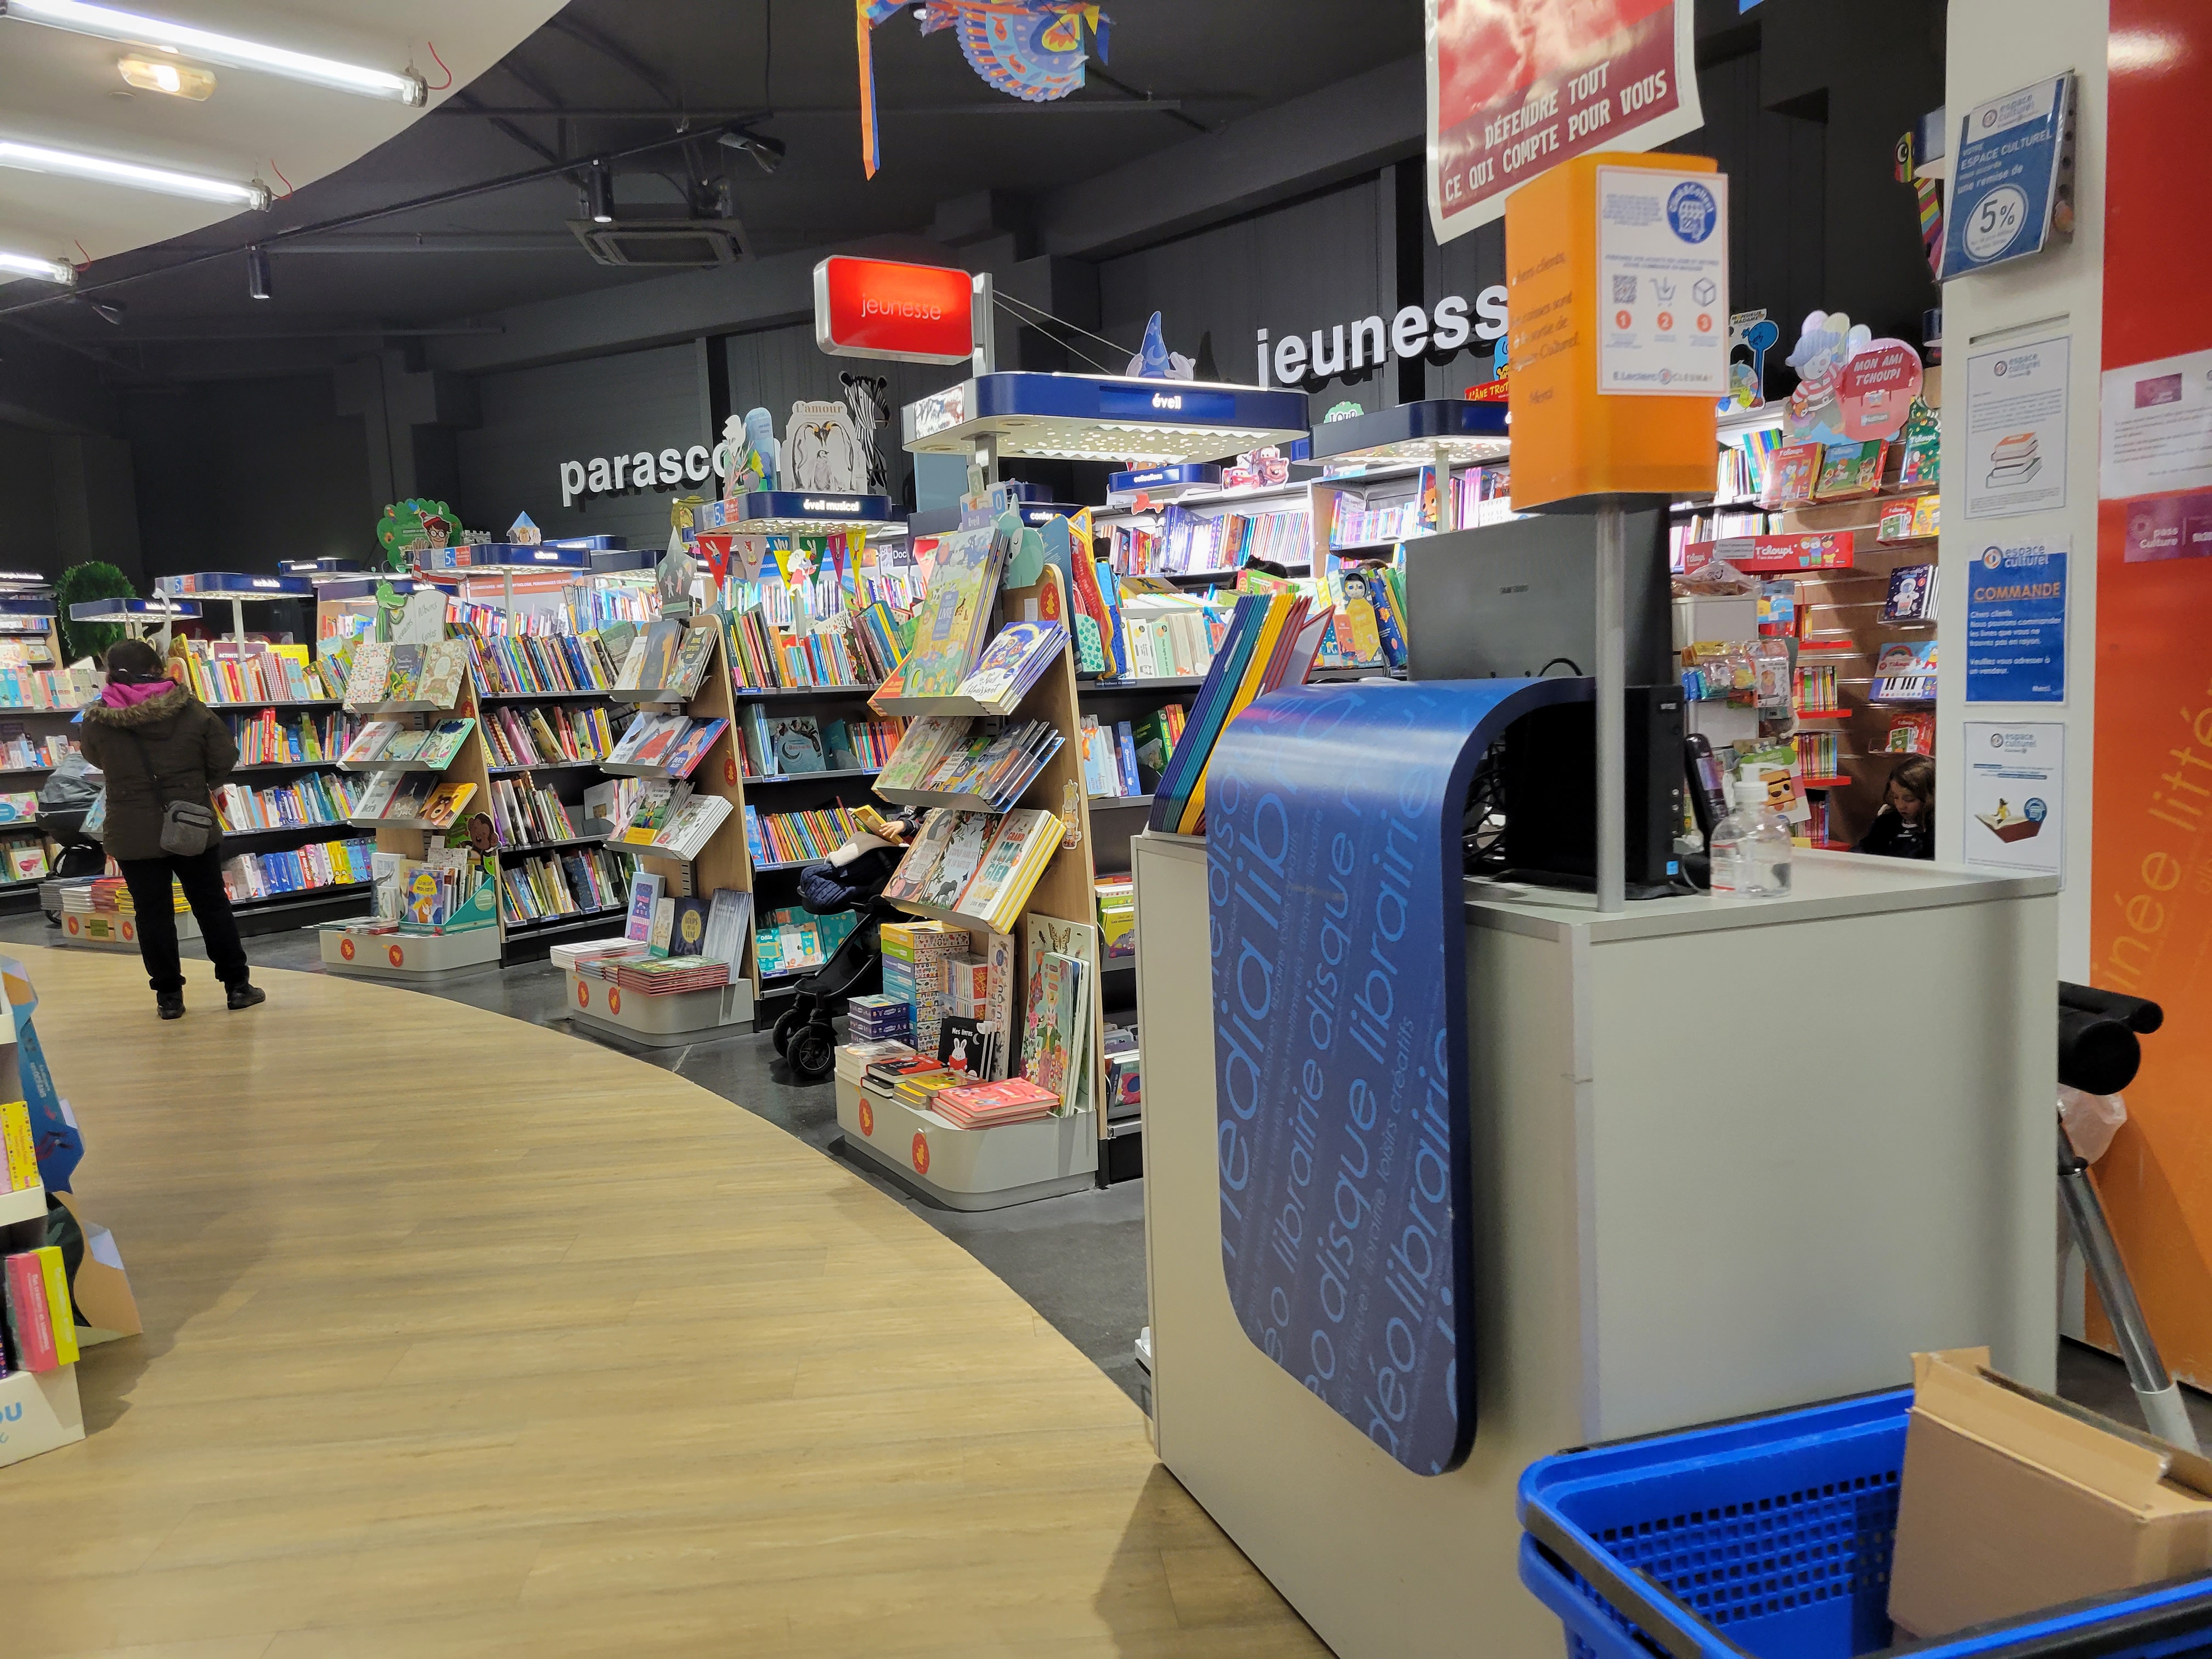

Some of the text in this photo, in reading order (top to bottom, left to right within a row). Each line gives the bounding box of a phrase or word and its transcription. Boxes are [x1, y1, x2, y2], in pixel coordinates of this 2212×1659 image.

[1485, 61, 1610, 150] DÉFENDRE TOUT
[1445, 69, 1667, 202] CE QUI COMPTE POUR VOUS
[1960, 129, 2052, 171] ESPACE CULTUREL
[1977, 170, 2009, 187] remise
[2011, 164, 2023, 176] de
[1979, 198, 2016, 234] 5%
[861, 293, 941, 320] jeunesse
[1854, 353, 1904, 372] MON AMI
[826, 500, 860, 511] musical
[1030, 511, 1053, 521] contes
[534, 551, 558, 560] albums
[2005, 544, 2046, 558] espace
[2004, 554, 2049, 568] culturel
[1974, 582, 2062, 601] COMMANDE
[938, 607, 953, 620] LIVRE
[1007, 832, 1026, 842] GRAND
[685, 917, 698, 926] LOUPS
[952, 1027, 973, 1036] Mes livres
[1271, 1058, 1325, 1274] librairie
[1310, 831, 1356, 1051] disque
[1375, 1119, 1396, 1181] loisirs
[1388, 1016, 1413, 1114] créatifs
[1316, 1079, 1378, 1323] disque
